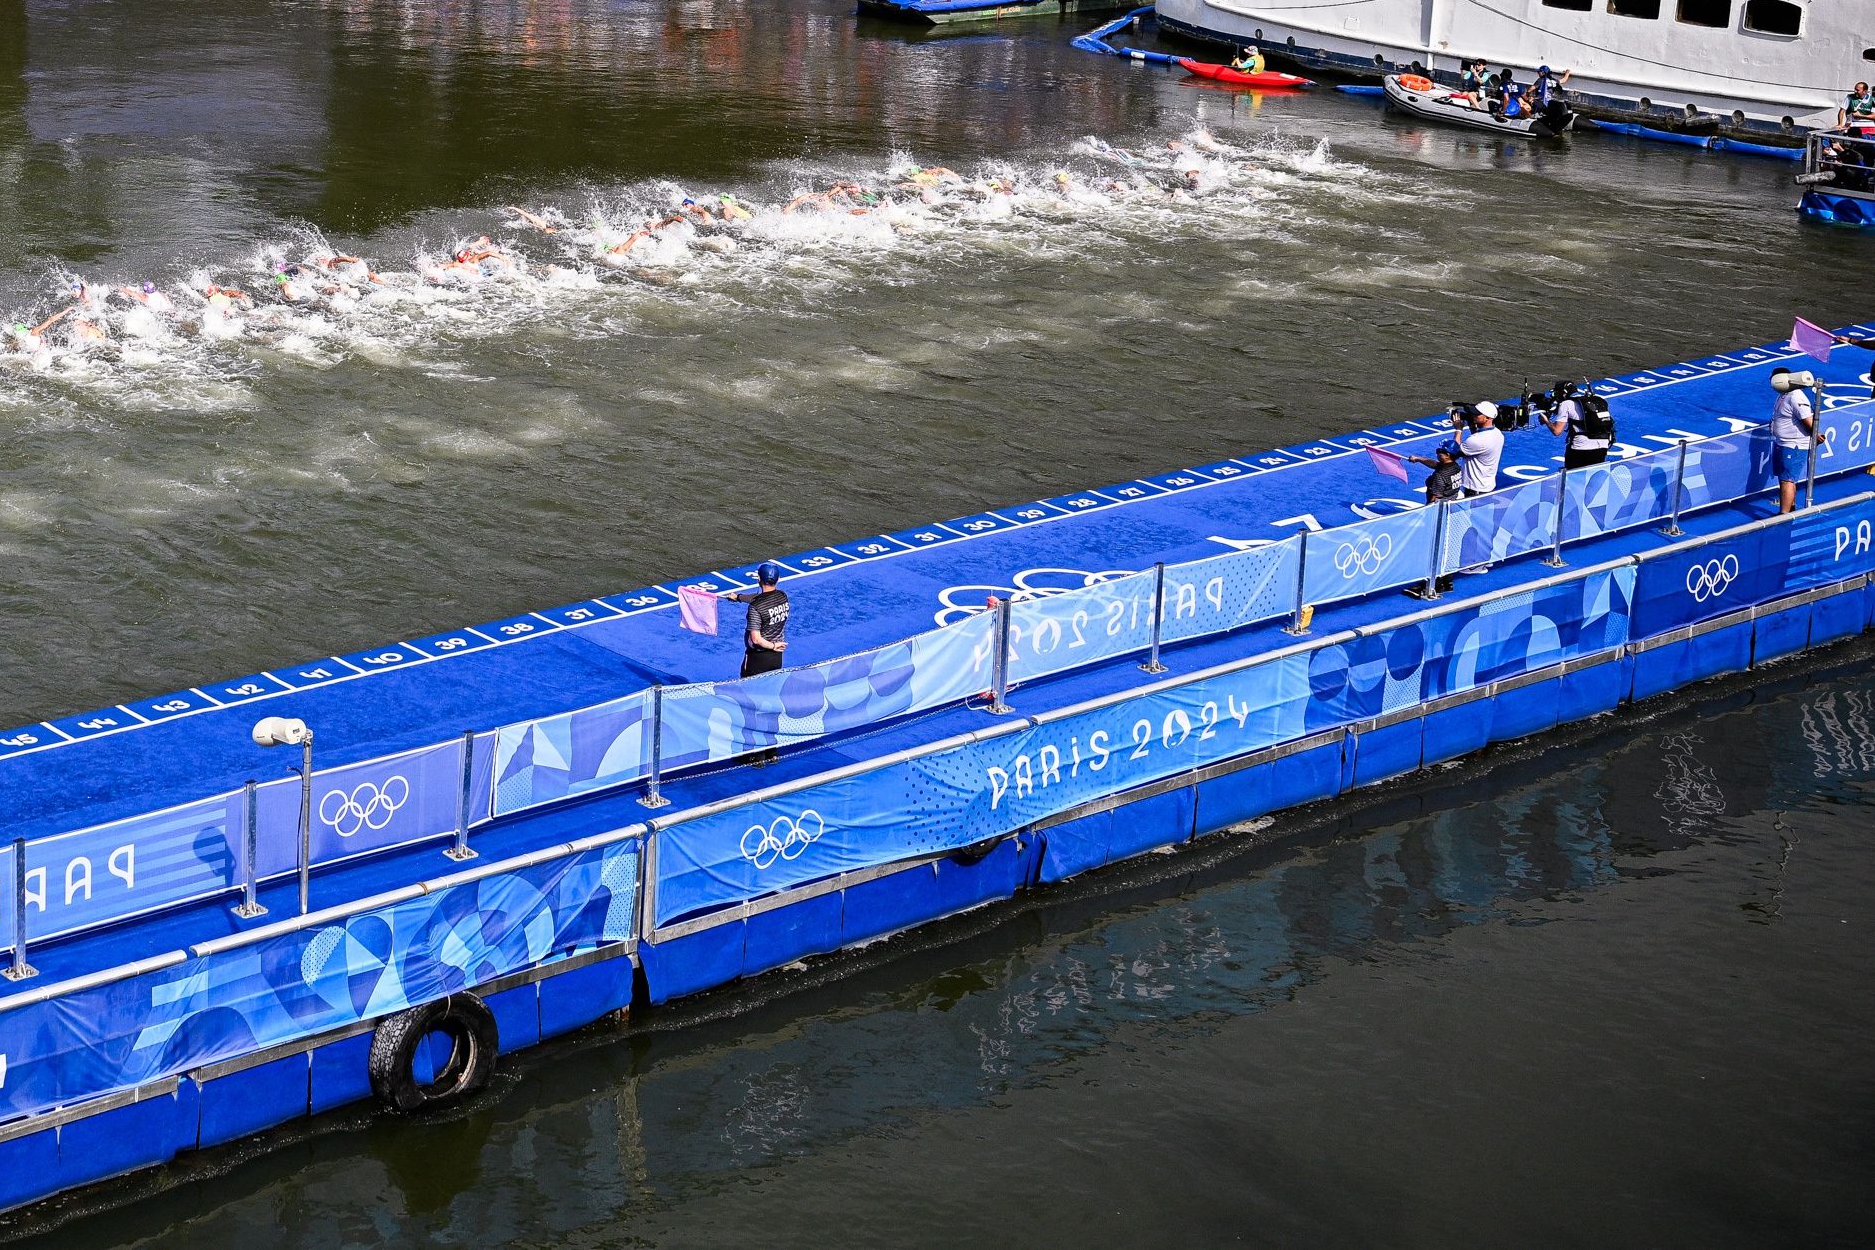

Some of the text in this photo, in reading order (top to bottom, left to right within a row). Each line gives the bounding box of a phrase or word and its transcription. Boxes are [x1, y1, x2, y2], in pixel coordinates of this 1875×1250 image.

[1349, 437, 1377, 446] 22
[1304, 447, 1331, 455] 23
[1213, 467, 1241, 475] 25
[1166, 477, 1194, 486] 26
[1119, 488, 1145, 496] 27
[1068, 499, 1097, 507] 28
[1017, 510, 1045, 518] 29
[964, 521, 996, 530] 30
[915, 532, 942, 541] 31
[858, 544, 890, 554] 32
[802, 557, 833, 566] 33
[745, 571, 759, 580] 3
[626, 595, 658, 607] 36
[565, 608, 594, 619] 37
[768, 602, 790, 618] PARIS
[500, 624, 534, 634] 38
[435, 638, 467, 649] 39
[363, 653, 403, 664] 40
[300, 668, 332, 678] 41
[225, 684, 264, 695] 42
[152, 700, 190, 711] 43
[78, 718, 117, 729] 44
[1129, 695, 1248, 761] 2024
[0, 734, 38, 746] 45
